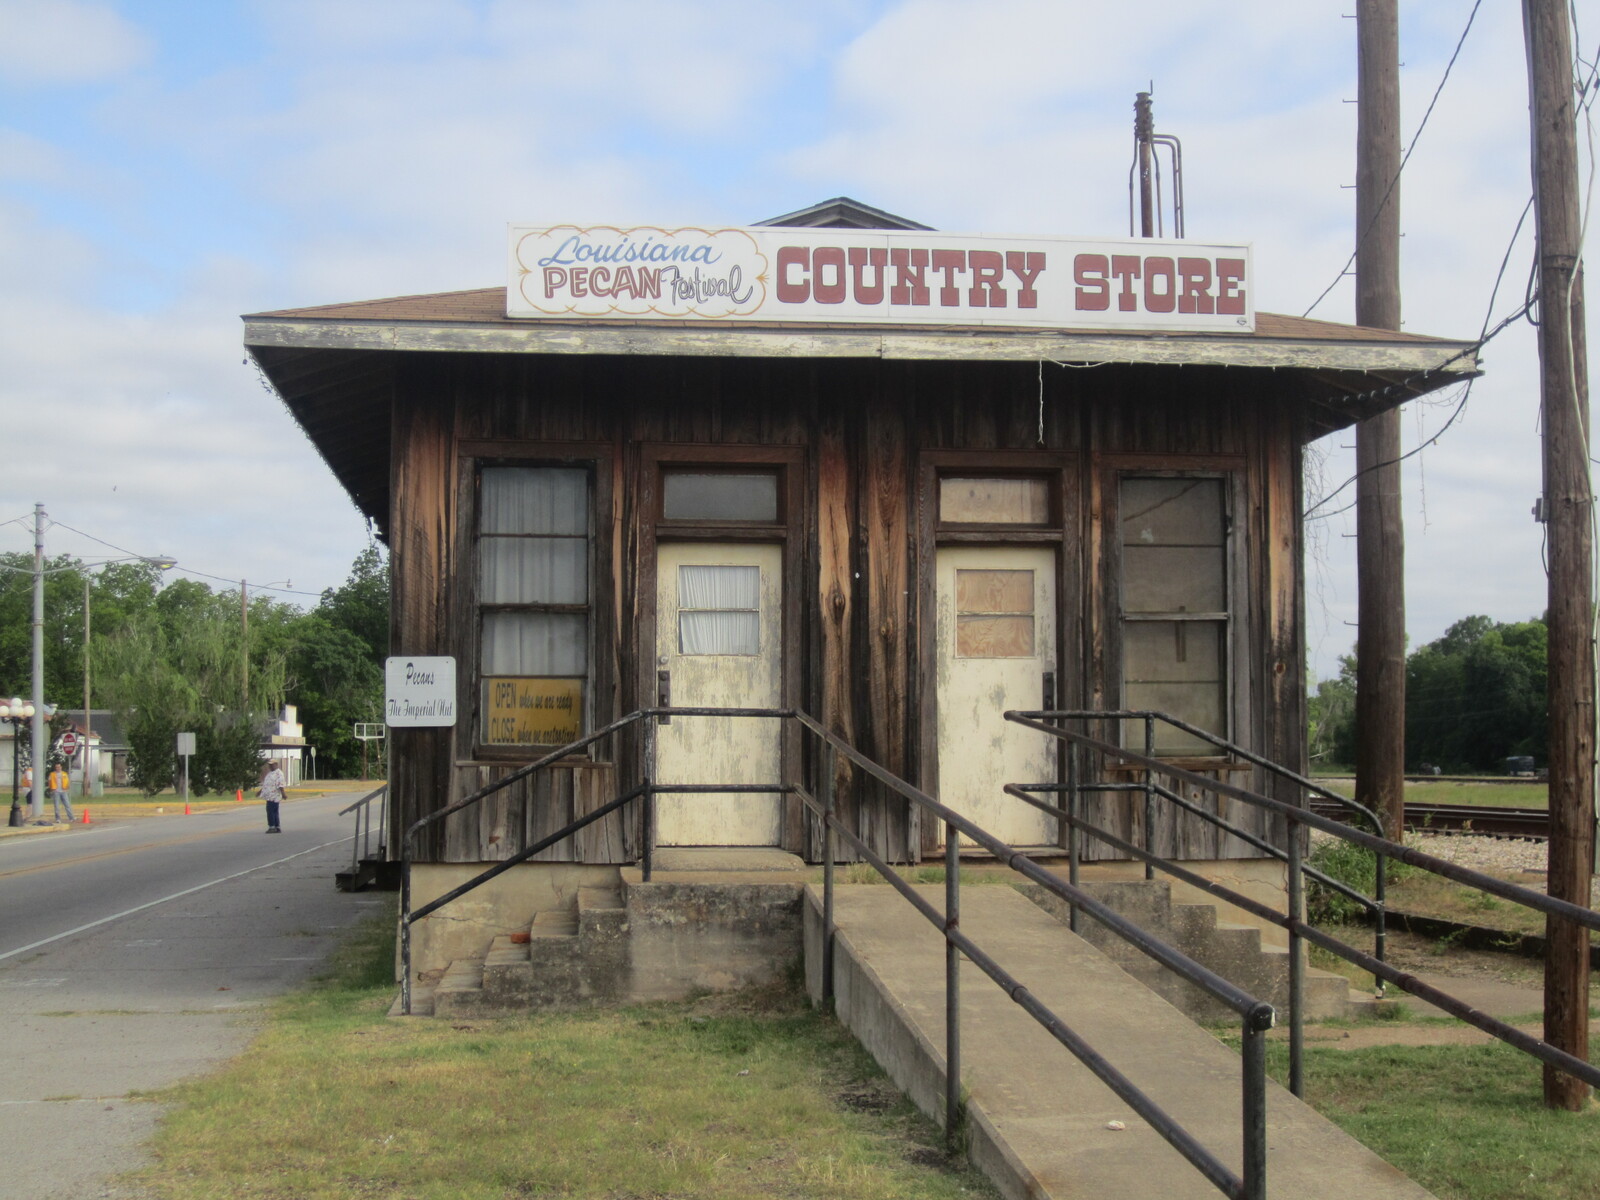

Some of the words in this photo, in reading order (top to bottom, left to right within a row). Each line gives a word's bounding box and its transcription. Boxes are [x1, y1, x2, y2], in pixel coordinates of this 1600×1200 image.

[538, 235, 722, 268] Louisiana
[542, 265, 663, 300] PECAN
[661, 264, 753, 306] Festival
[776, 246, 1047, 309] COUNTRY
[1073, 253, 1246, 316] STORE
[405, 662, 434, 686] Pecans
[388, 698, 401, 716] The
[403, 698, 436, 720] Imperial
[437, 698, 453, 717] Nut
[495, 682, 517, 709] OPEN
[492, 717, 515, 743] CLOSE
